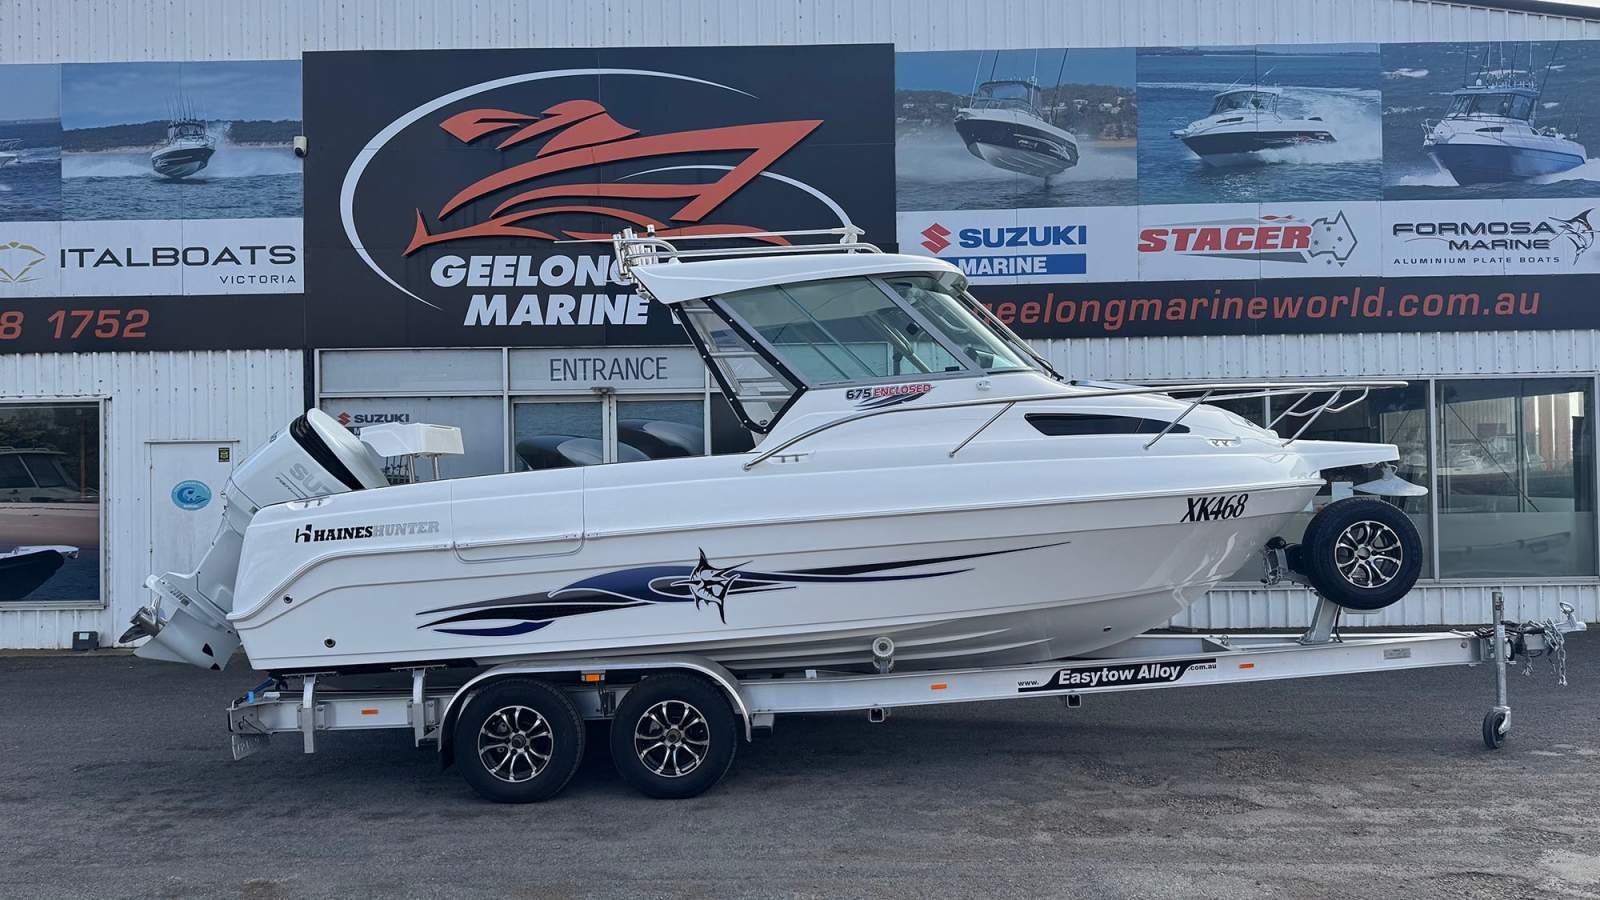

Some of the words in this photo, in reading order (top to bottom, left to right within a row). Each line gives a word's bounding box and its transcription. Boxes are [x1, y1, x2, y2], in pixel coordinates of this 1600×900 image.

[959, 225, 1087, 248] SUZUKI
[1137, 226, 1312, 252] STACER
[1393, 222, 1556, 236] FORMOSA
[1449, 239, 1550, 250] MARINE
[60, 245, 297, 268] ITALBOATS
[959, 257, 1047, 275] MARINE
[219, 275, 296, 284] VICTORIA
[463, 294, 649, 326] MARINE
[48, 309, 150, 339] 1752
[550, 357, 668, 382] ENTRANCE
[846, 389, 871, 399] 675
[873, 384, 931, 398] ENCLOSED
[354, 413, 410, 424] SUZUKI
[1180, 493, 1249, 523] XK468
[1058, 669, 1135, 687] Easytow
[1137, 664, 1181, 682] Alloy
